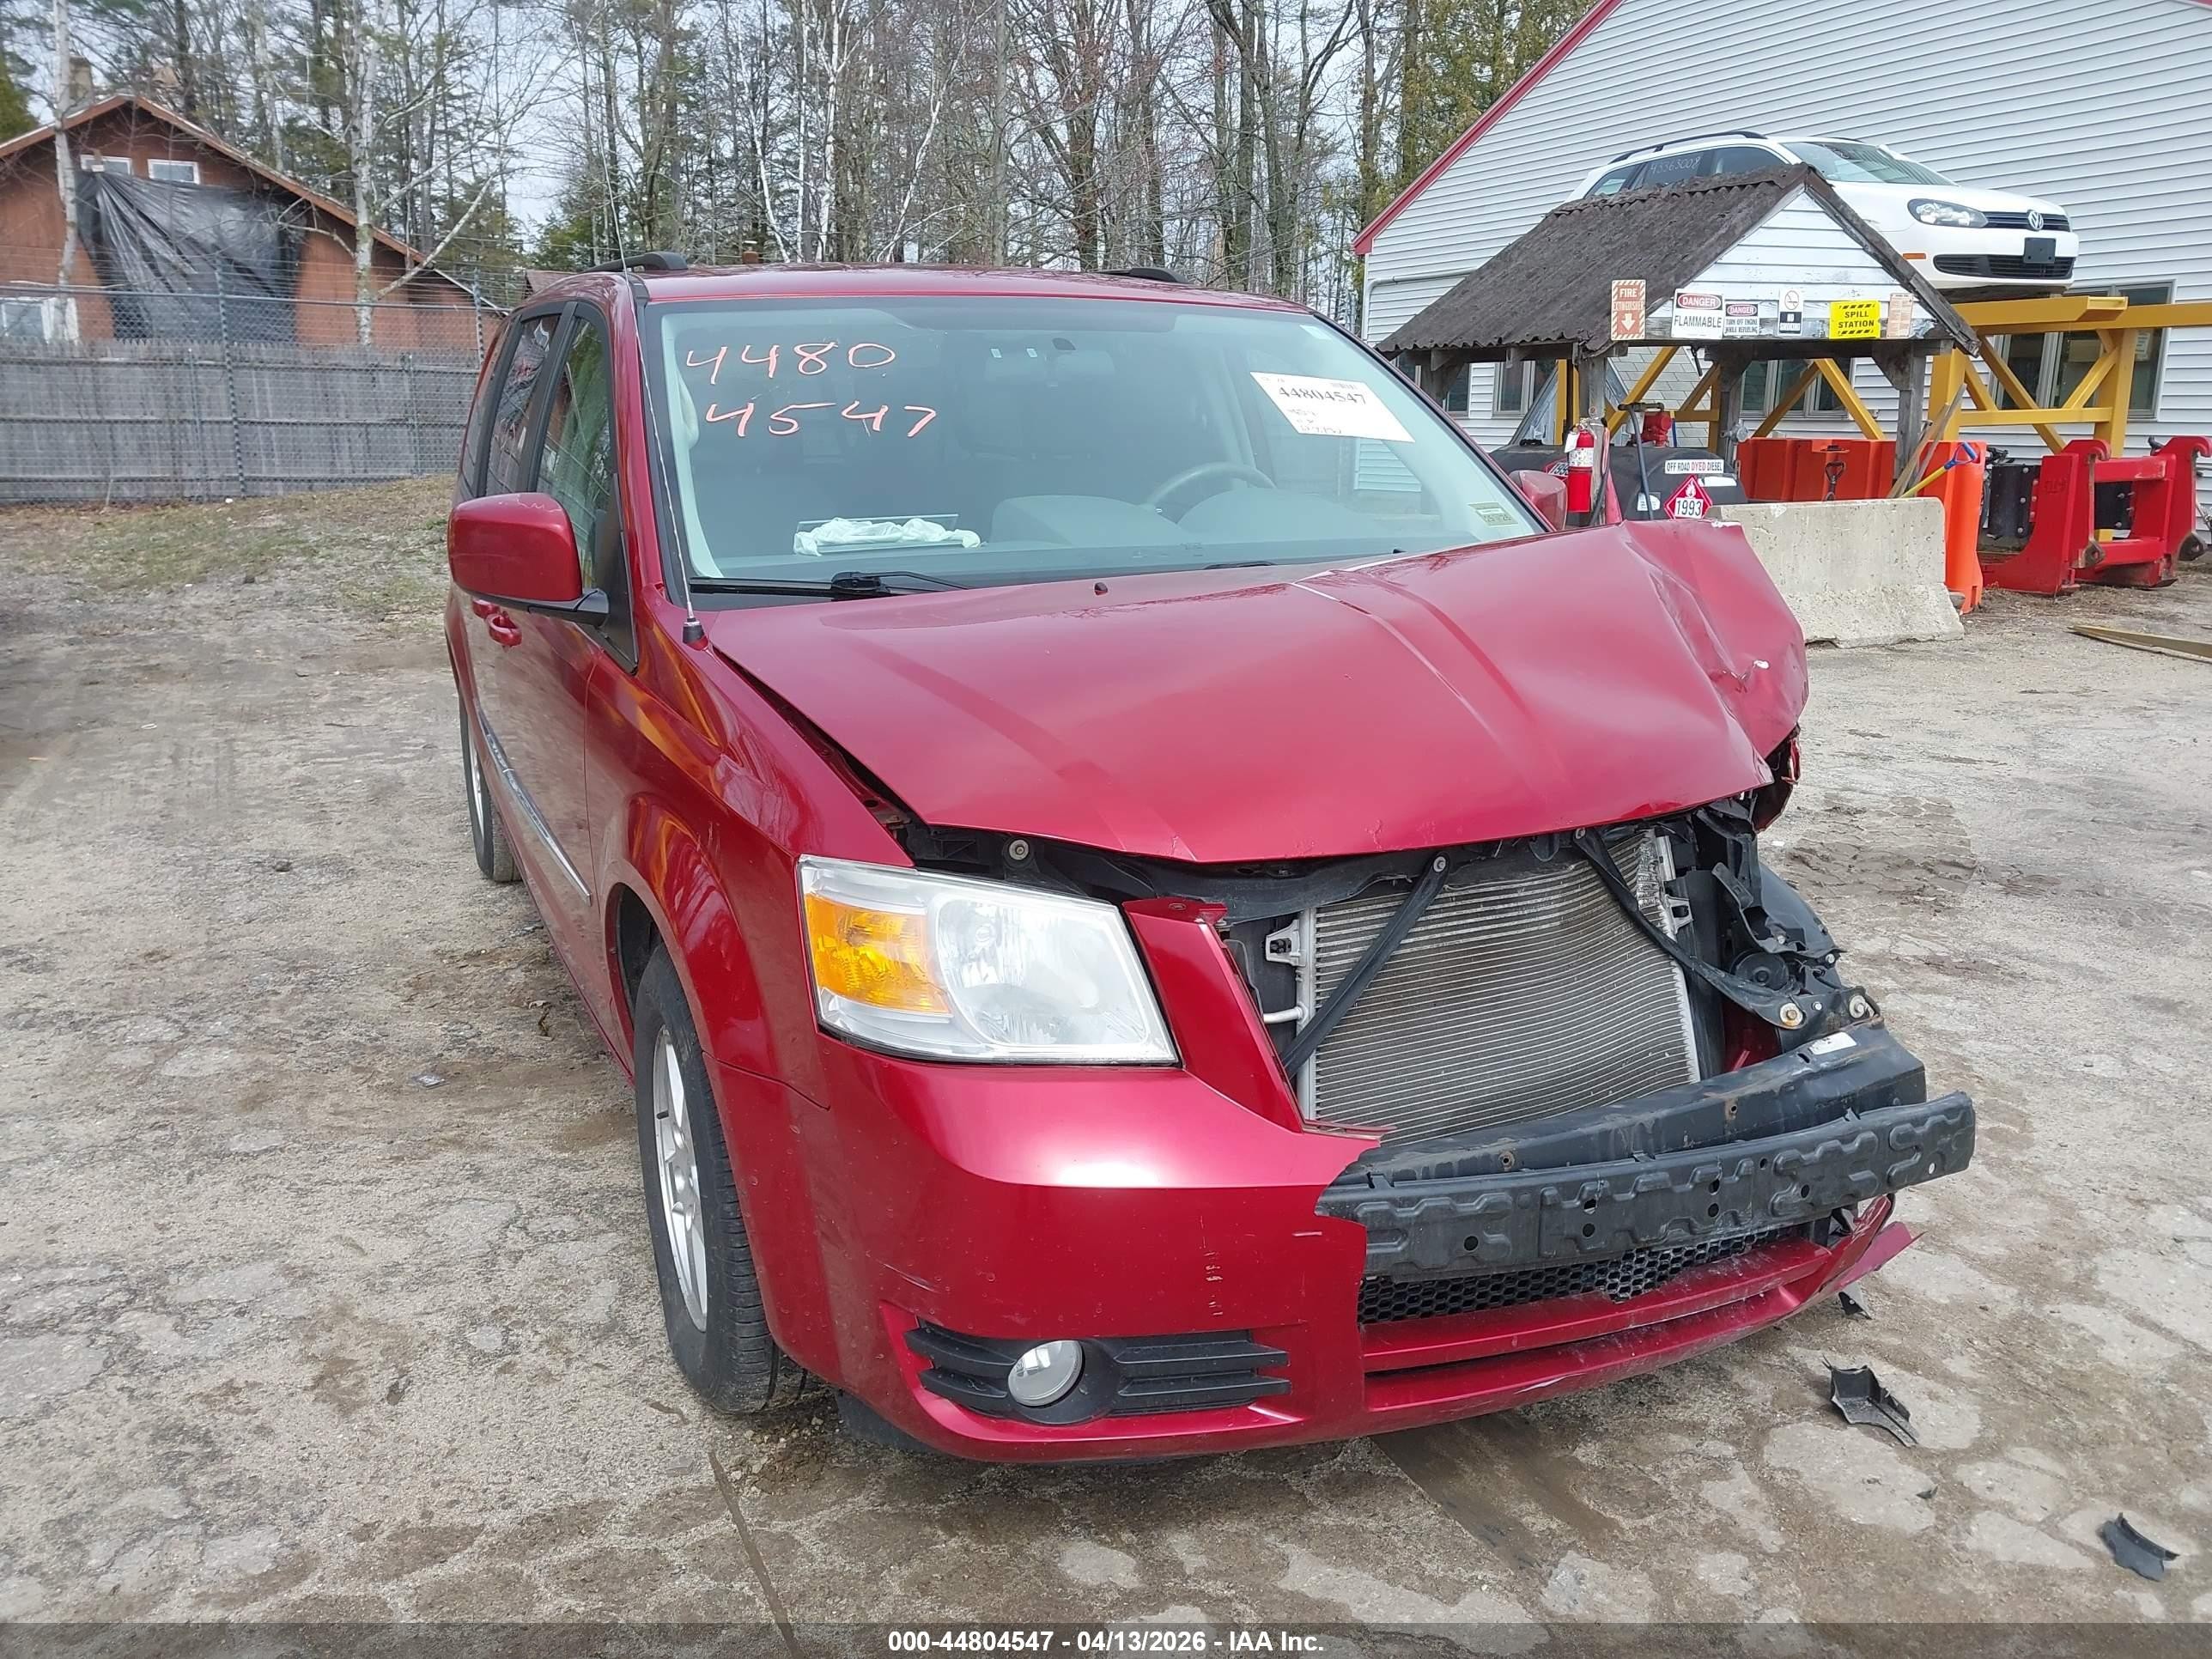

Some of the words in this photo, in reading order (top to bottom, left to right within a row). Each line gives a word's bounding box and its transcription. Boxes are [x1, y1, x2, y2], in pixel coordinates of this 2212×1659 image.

[1620, 288, 1638, 298] FIRE
[1682, 295, 1717, 307] DANGER
[1729, 306, 1754, 315] DANGER
[1674, 315, 1723, 329] FLAMMABLE
[1838, 320, 1875, 329] STATION
[686, 341, 896, 386] 4480
[1279, 386, 1367, 405] 44804547
[705, 400, 938, 438] 4547
[1667, 462, 1677, 472] OFF
[1678, 462, 1690, 471] ROAD
[1691, 461, 1706, 471] DYED
[1707, 461, 1723, 471] DIESEL
[1677, 500, 1702, 516] 1993
